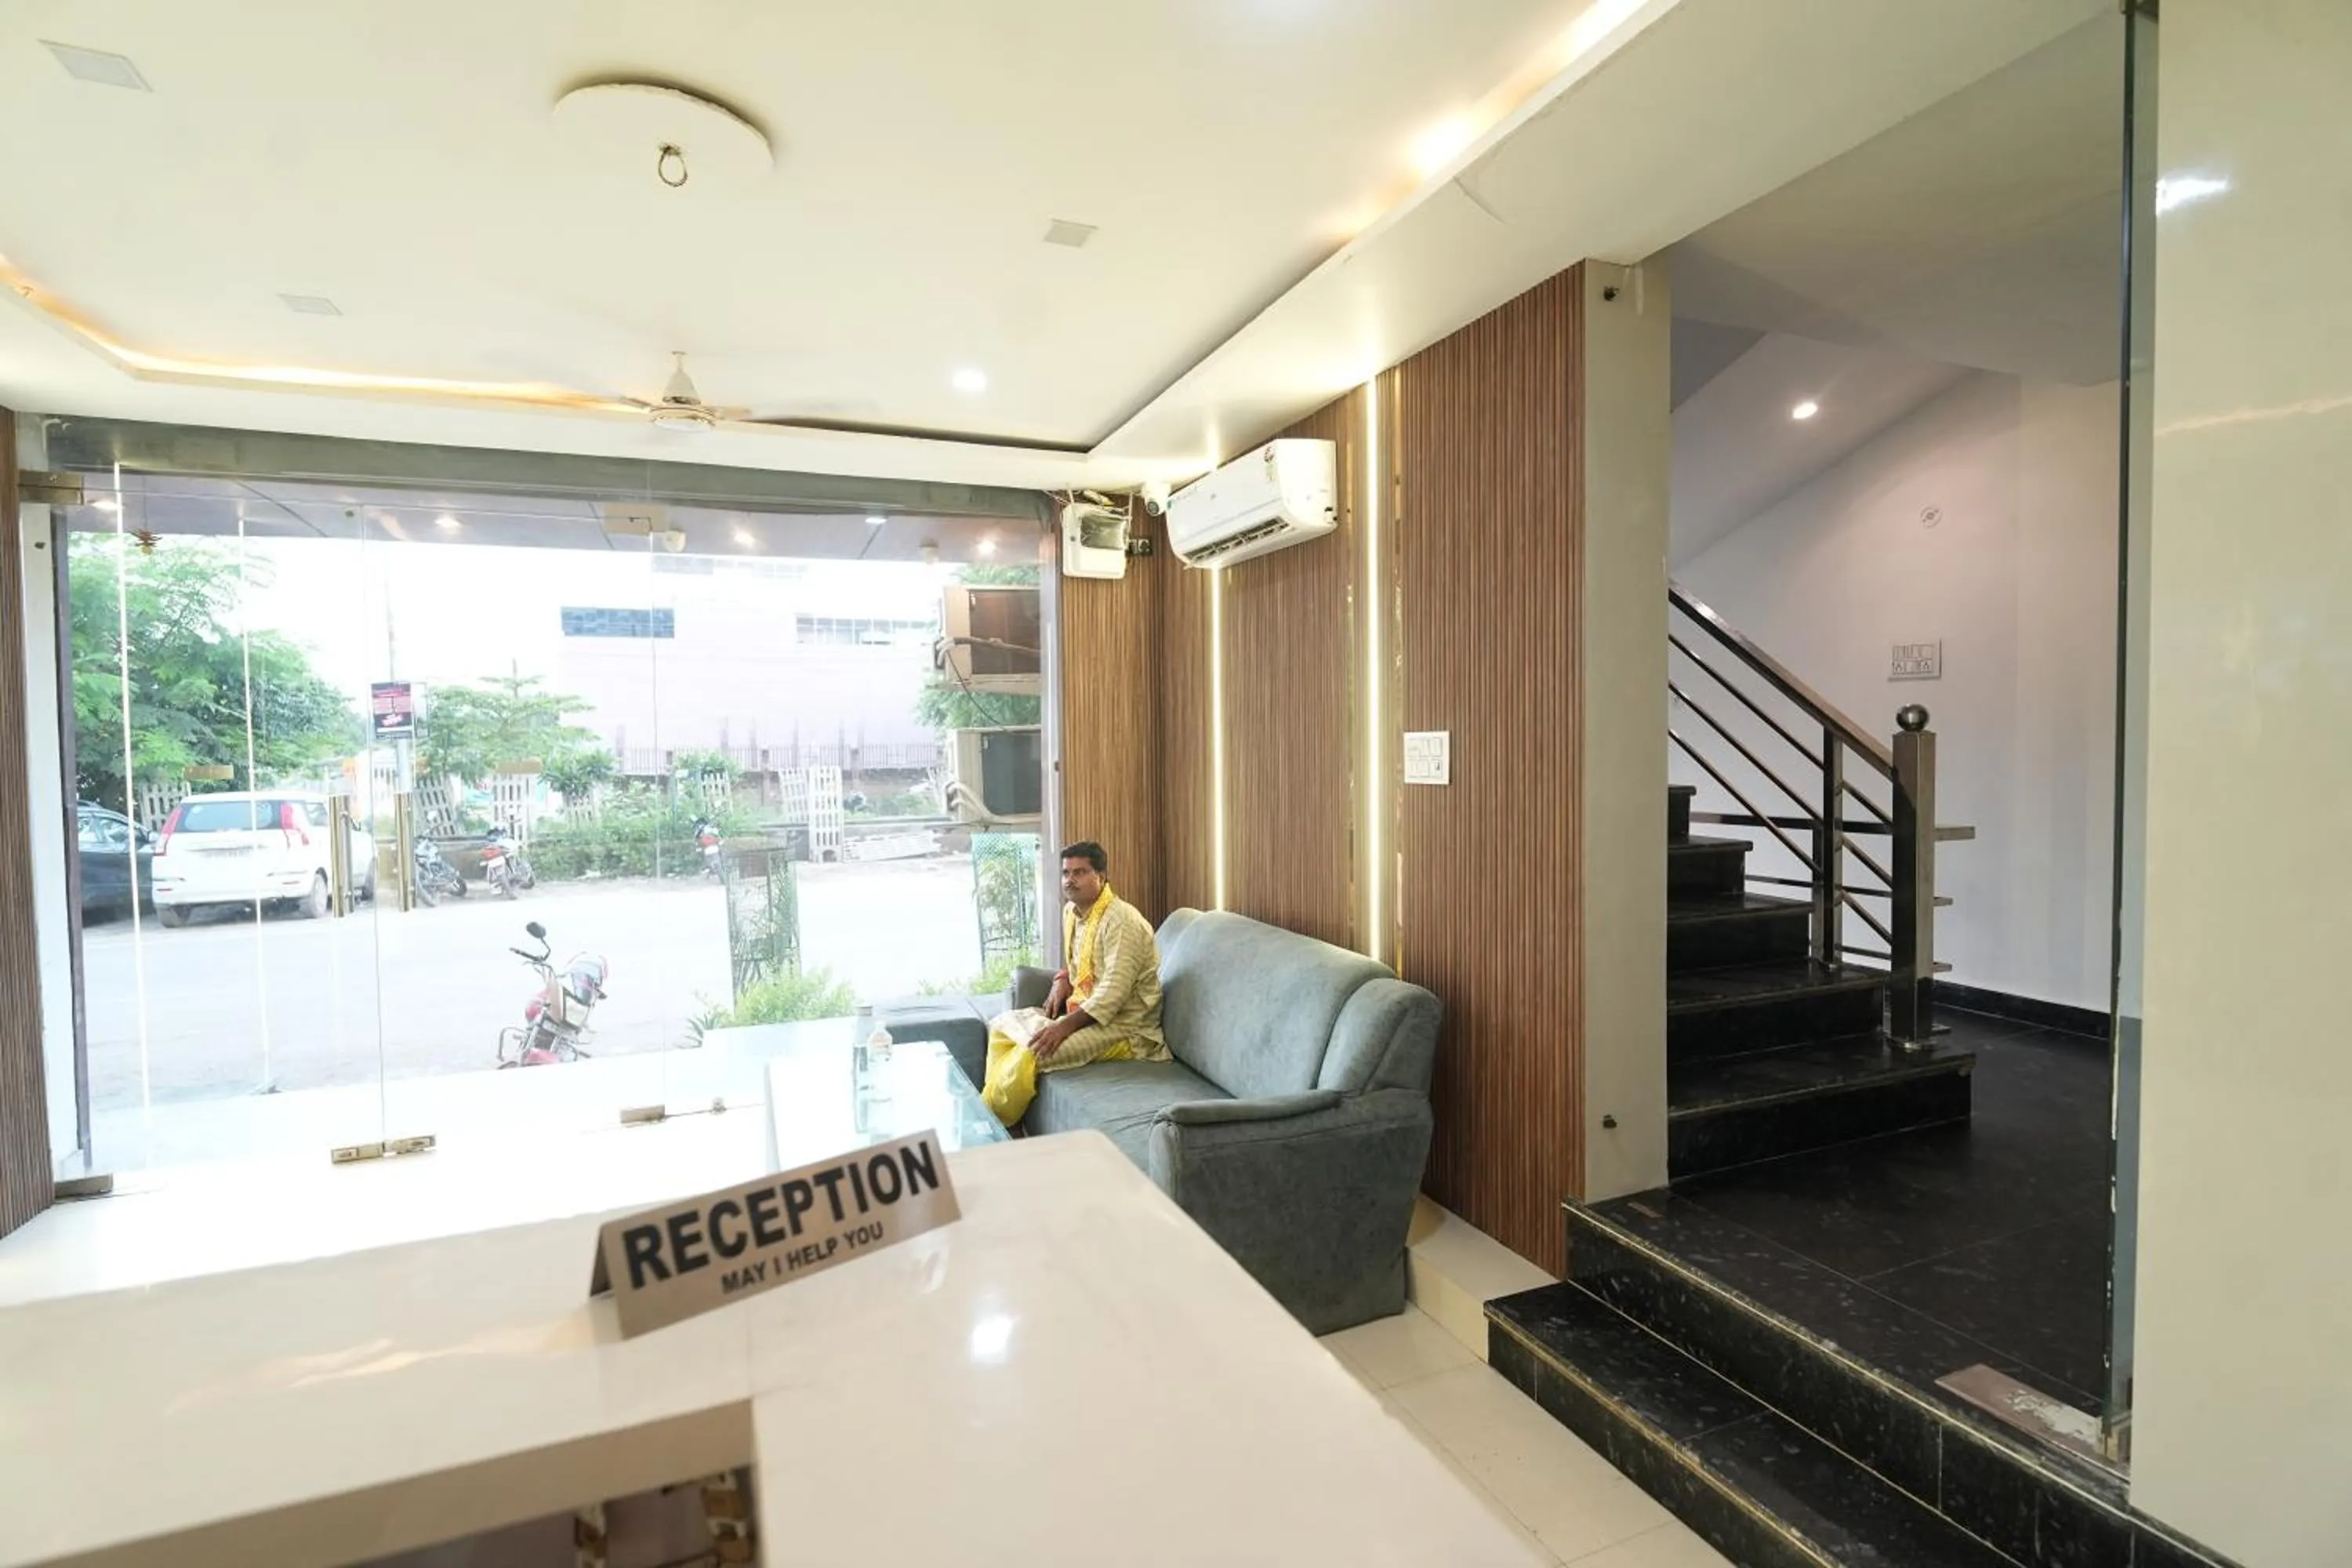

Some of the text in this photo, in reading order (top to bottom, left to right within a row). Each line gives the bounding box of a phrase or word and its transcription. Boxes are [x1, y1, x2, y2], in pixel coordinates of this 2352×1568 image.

[623, 1142, 939, 1290] RECEPTION
[722, 1221, 883, 1294] MAY I HELP YOU
